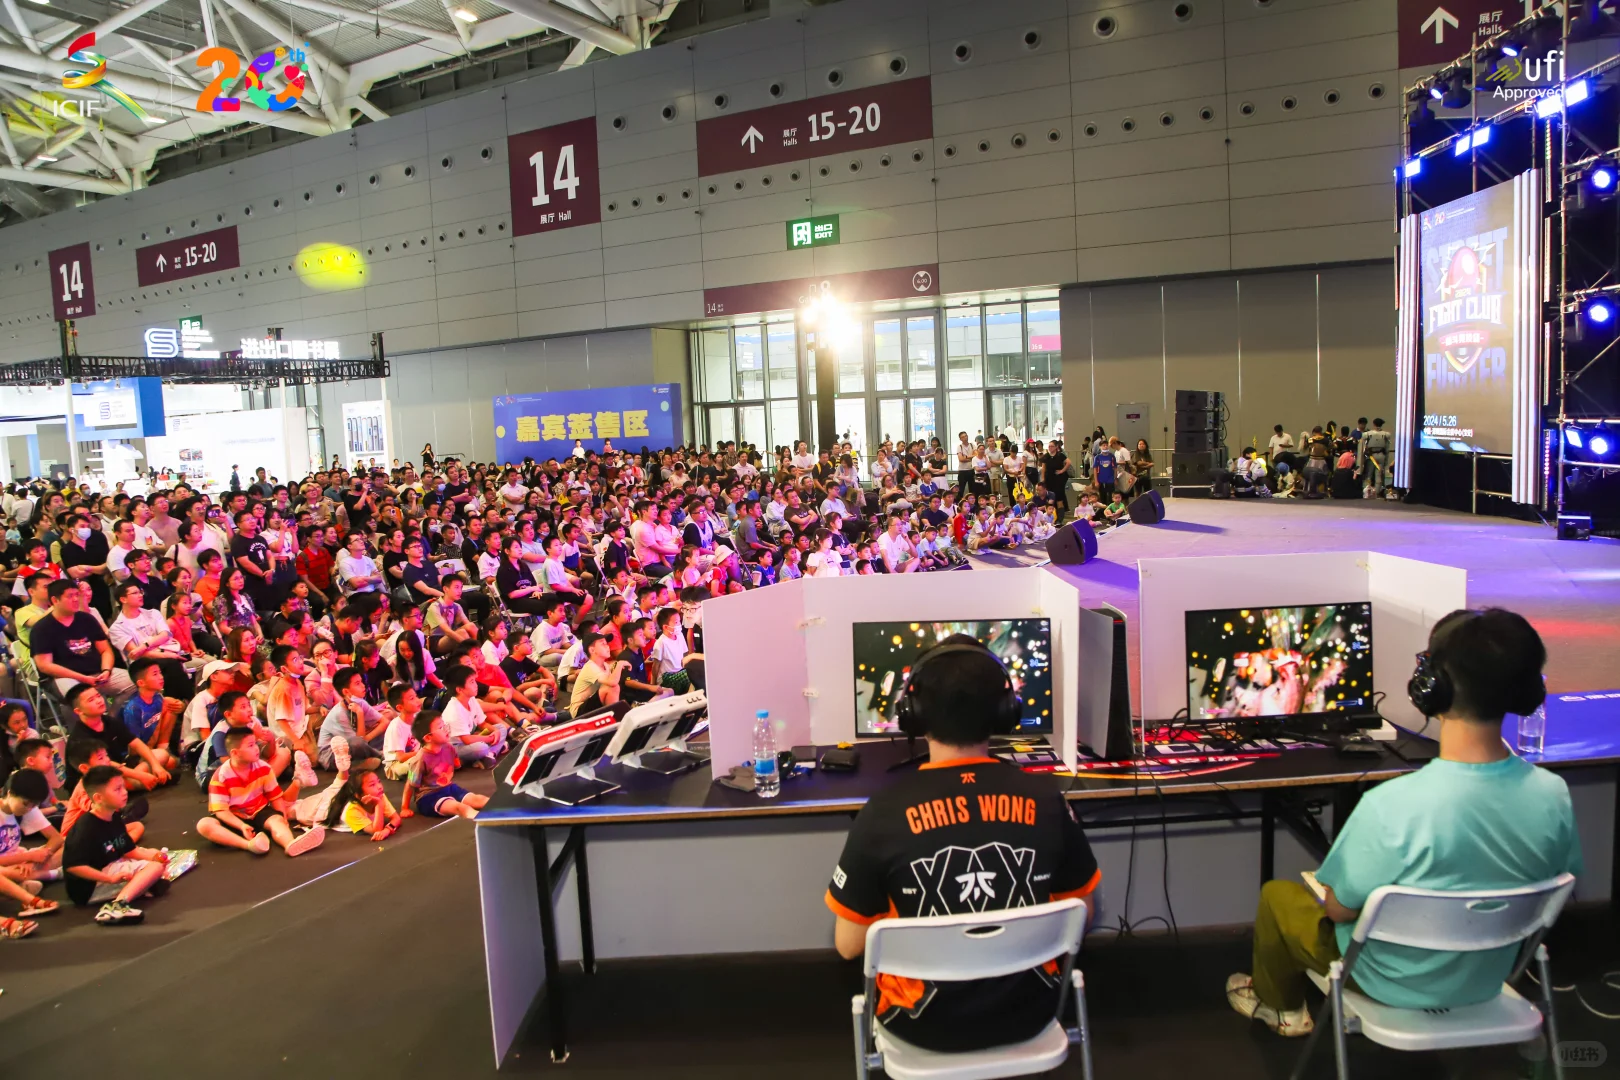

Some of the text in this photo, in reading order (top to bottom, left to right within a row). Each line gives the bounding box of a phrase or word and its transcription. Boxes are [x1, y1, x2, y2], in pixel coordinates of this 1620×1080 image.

[1478, 10, 1503, 24] 展厅
[1478, 25, 1503, 36] Halls
[808, 102, 881, 143] 15-20
[782, 127, 798, 138] 展厅
[782, 137, 798, 147] Halls
[529, 144, 580, 207] 14
[540, 210, 572, 225] 展厅 Hall
[814, 224, 833, 232] 出口
[814, 231, 833, 239] EXIT
[185, 241, 217, 267] 15-20
[59, 261, 84, 302] 14
[707, 303, 716, 313] 14
[516, 409, 650, 443] 嘉宾签售区
[905, 793, 1037, 835] CHRIS WONG
[902, 888, 918, 896] EST
